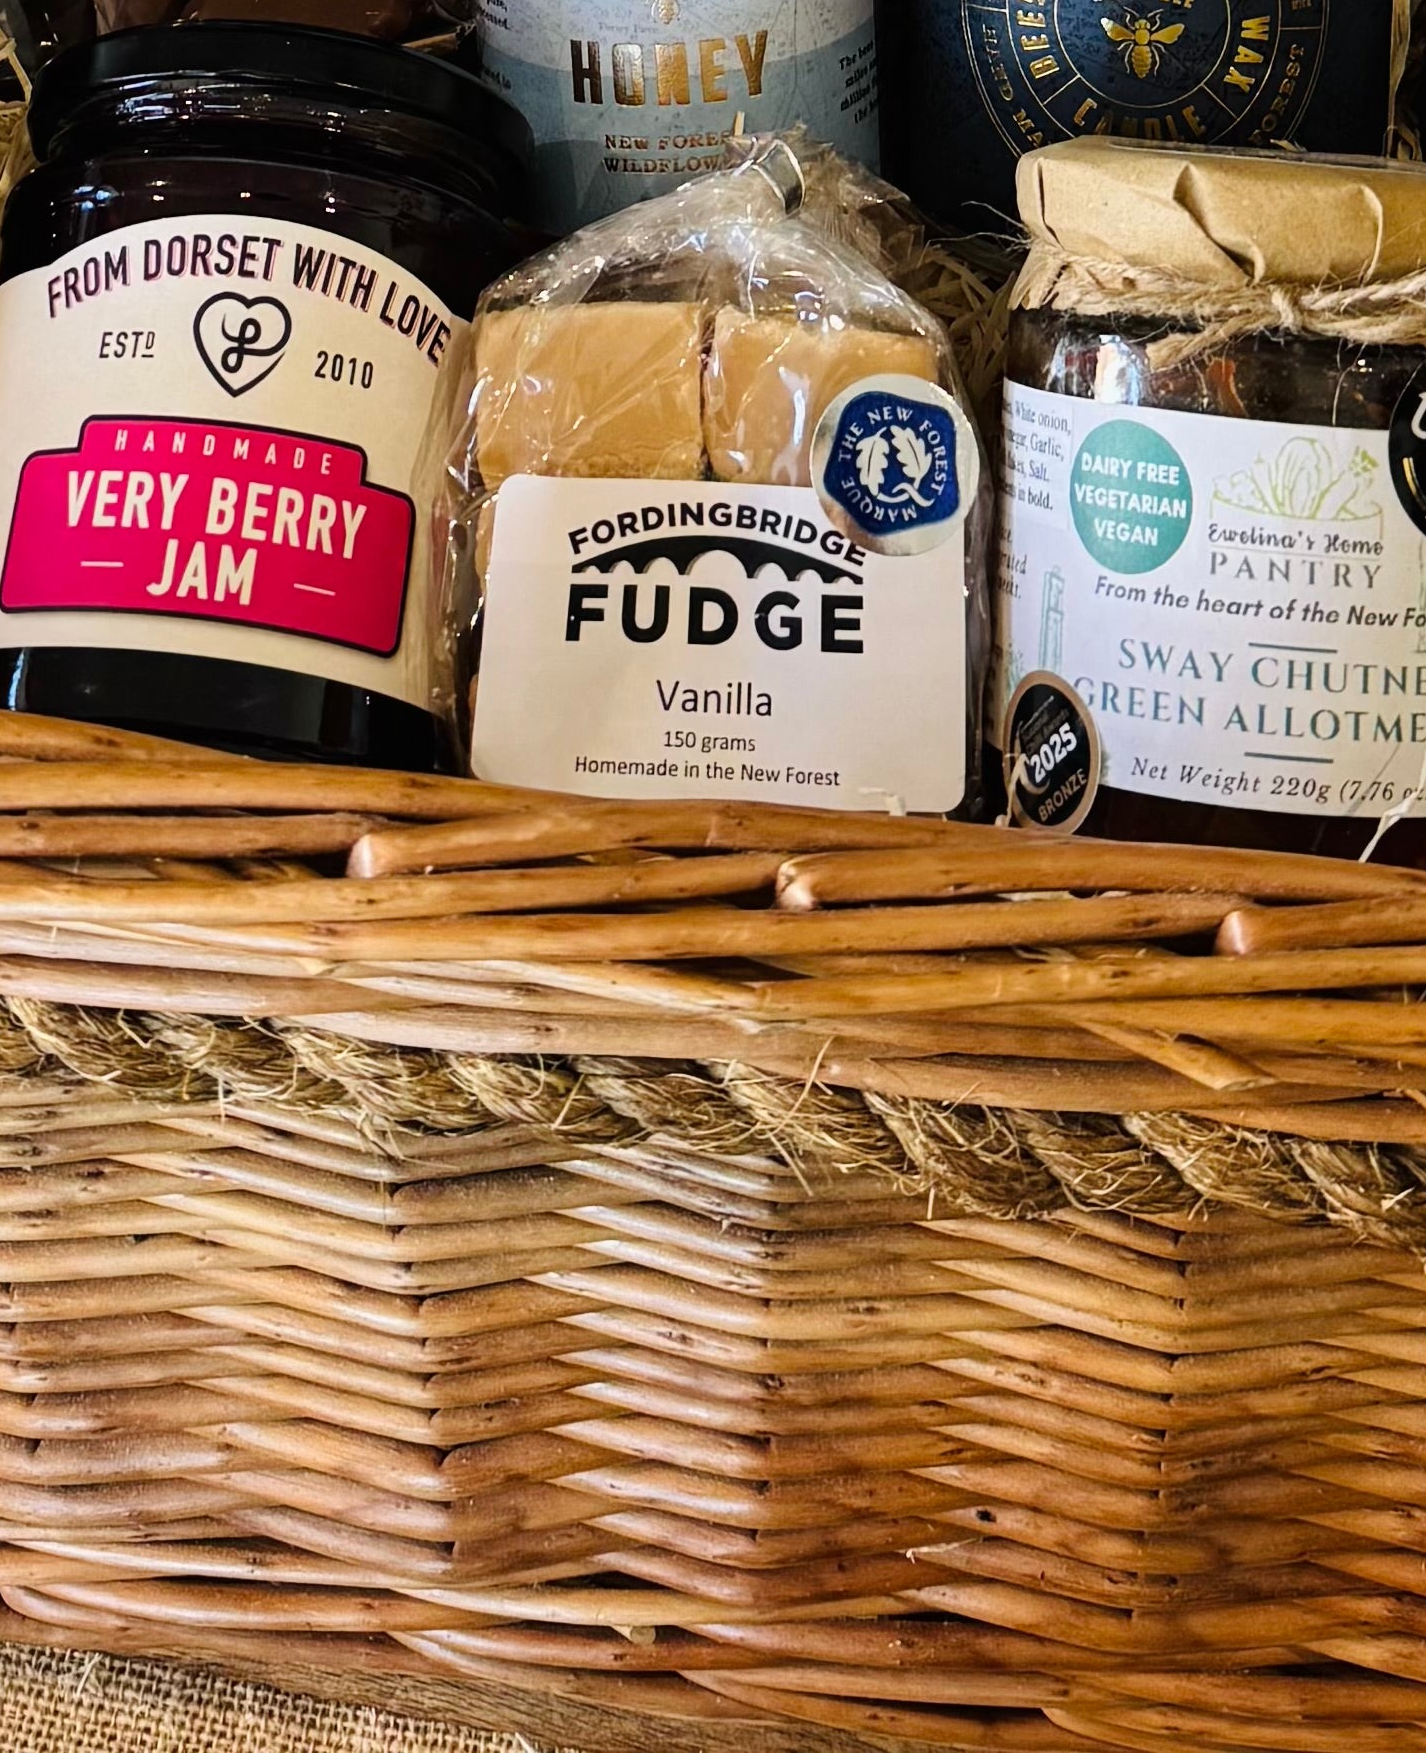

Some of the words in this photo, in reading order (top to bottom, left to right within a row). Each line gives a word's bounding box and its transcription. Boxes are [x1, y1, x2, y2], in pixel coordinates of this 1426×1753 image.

[570, 29, 769, 108] HONEY
[1080, 453, 1131, 480] DAIRY
[1137, 462, 1179, 486] FREE
[67, 470, 189, 530] VERY
[204, 478, 367, 560] BERRY
[1074, 483, 1187, 518] VEGETARIAN
[567, 502, 867, 567] FORDINGBRIDGE
[1093, 520, 1158, 546] VEGAN
[146, 538, 259, 606] JAM
[565, 583, 865, 654] FUDGE
[656, 680, 773, 717] Vanilla
[663, 731, 696, 749] 150
[701, 734, 756, 753] grams
